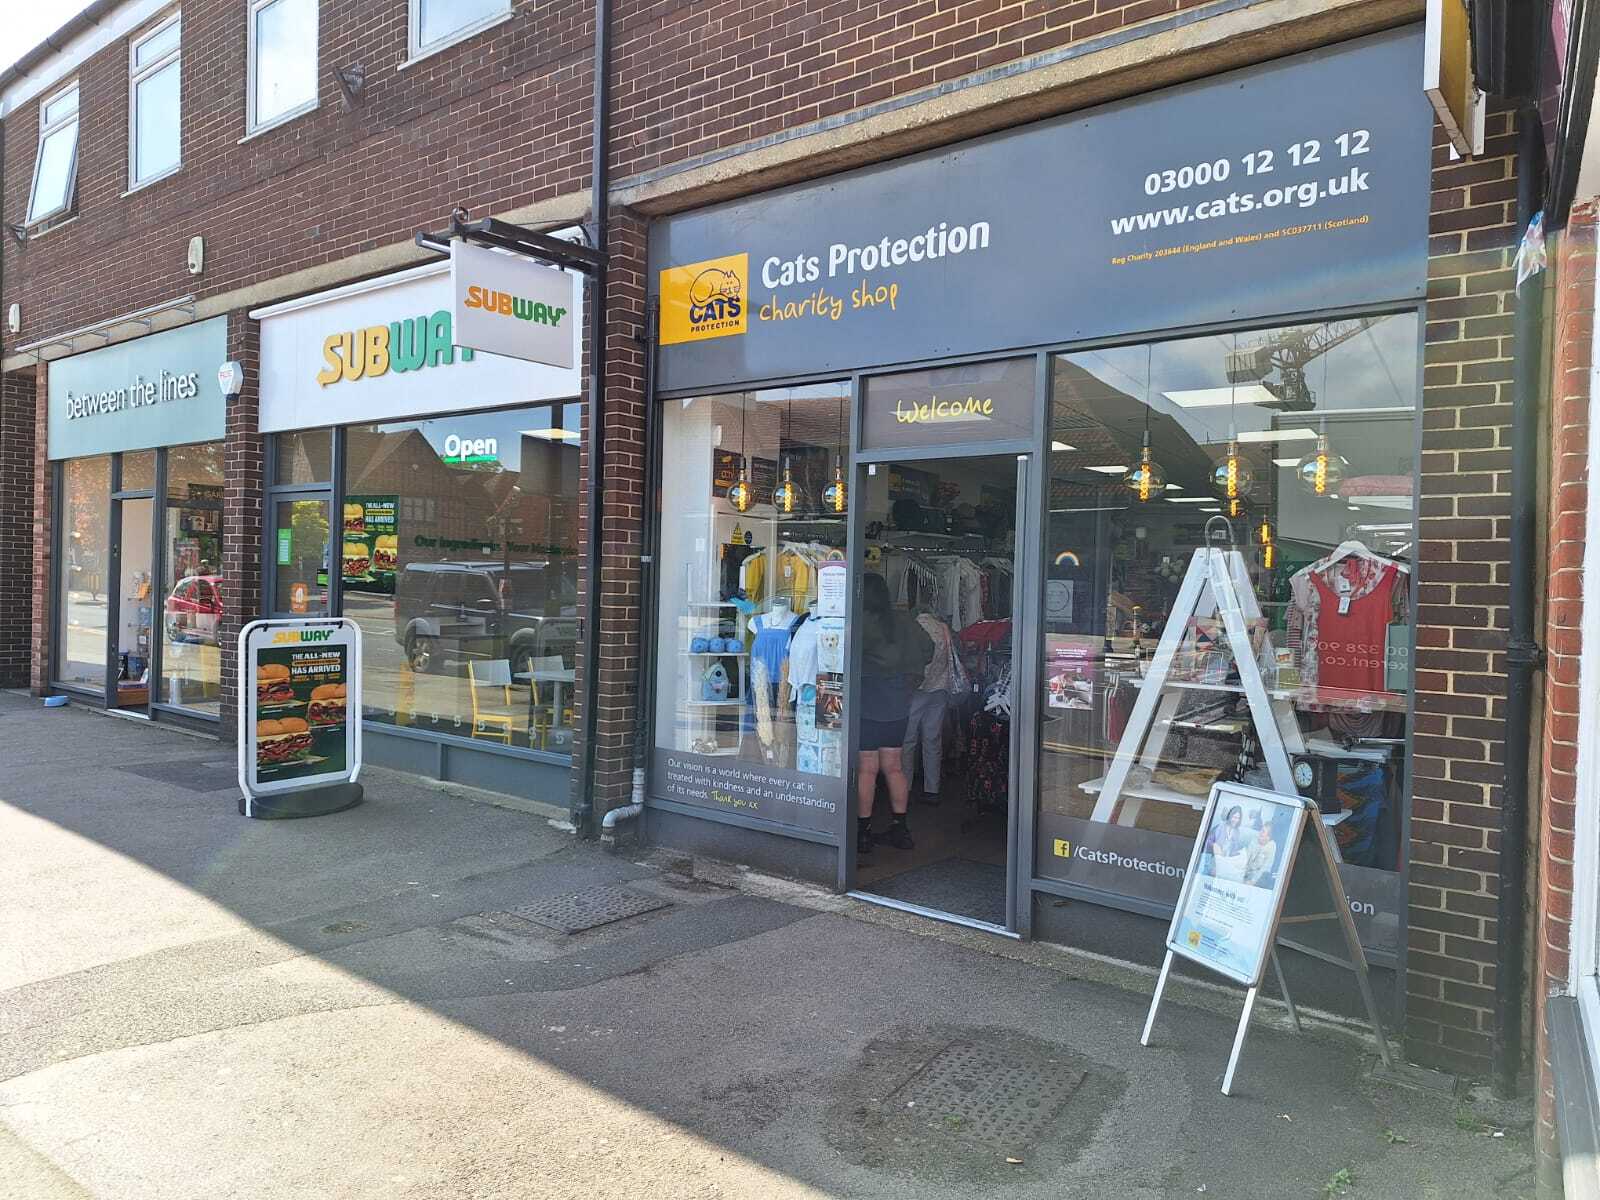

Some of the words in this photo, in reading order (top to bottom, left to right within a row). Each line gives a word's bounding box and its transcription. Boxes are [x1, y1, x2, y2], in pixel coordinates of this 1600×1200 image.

[1144, 158, 1231, 196] 03000
[1241, 150, 1275, 176] 12
[1287, 139, 1321, 167] 12
[1334, 129, 1371, 157] 12
[1110, 167, 1370, 236] www.cats.org.uk
[761, 253, 821, 290] Cats
[828, 221, 991, 277] Protection
[1111, 257, 1127, 266] Reg
[1127, 250, 1153, 263] Charity
[1183, 240, 1217, 254] (England
[1219, 237, 1234, 247] and
[1235, 232, 1263, 245] Wales)
[1264, 229, 1280, 240] and
[1324, 215, 1369, 230] (Scotland)
[463, 285, 567, 328] SUBWAY
[689, 297, 741, 324] CATS
[758, 287, 844, 322] charity
[851, 278, 899, 311] shop
[690, 319, 740, 333] PROTECTION
[315, 310, 475, 389] SUBWA
[65, 387, 127, 420] between
[130, 375, 157, 408] the
[159, 368, 199, 403] lines
[443, 434, 497, 462] Open
[272, 628, 335, 644] SUBWAY
[291, 666, 307, 675] HAS
[308, 664, 341, 674] ARRIVED
[304, 651, 341, 659] ALL-NEW
[667, 758, 681, 768] Our
[683, 762, 704, 773] vision
[705, 765, 711, 774] is
[712, 767, 717, 775] a
[719, 768, 741, 779] world
[742, 771, 767, 783] where
[768, 777, 790, 789] every
[792, 780, 805, 790] cat
[807, 781, 814, 792] is
[667, 783, 675, 792] of
[676, 785, 685, 795] its
[667, 772, 693, 783] treated
[694, 776, 711, 787] with
[712, 780, 745, 793] kindness
[746, 786, 761, 796] and
[763, 789, 773, 798] an
[775, 792, 836, 813] understanding
[1073, 845, 1186, 879] /CatsProtection
